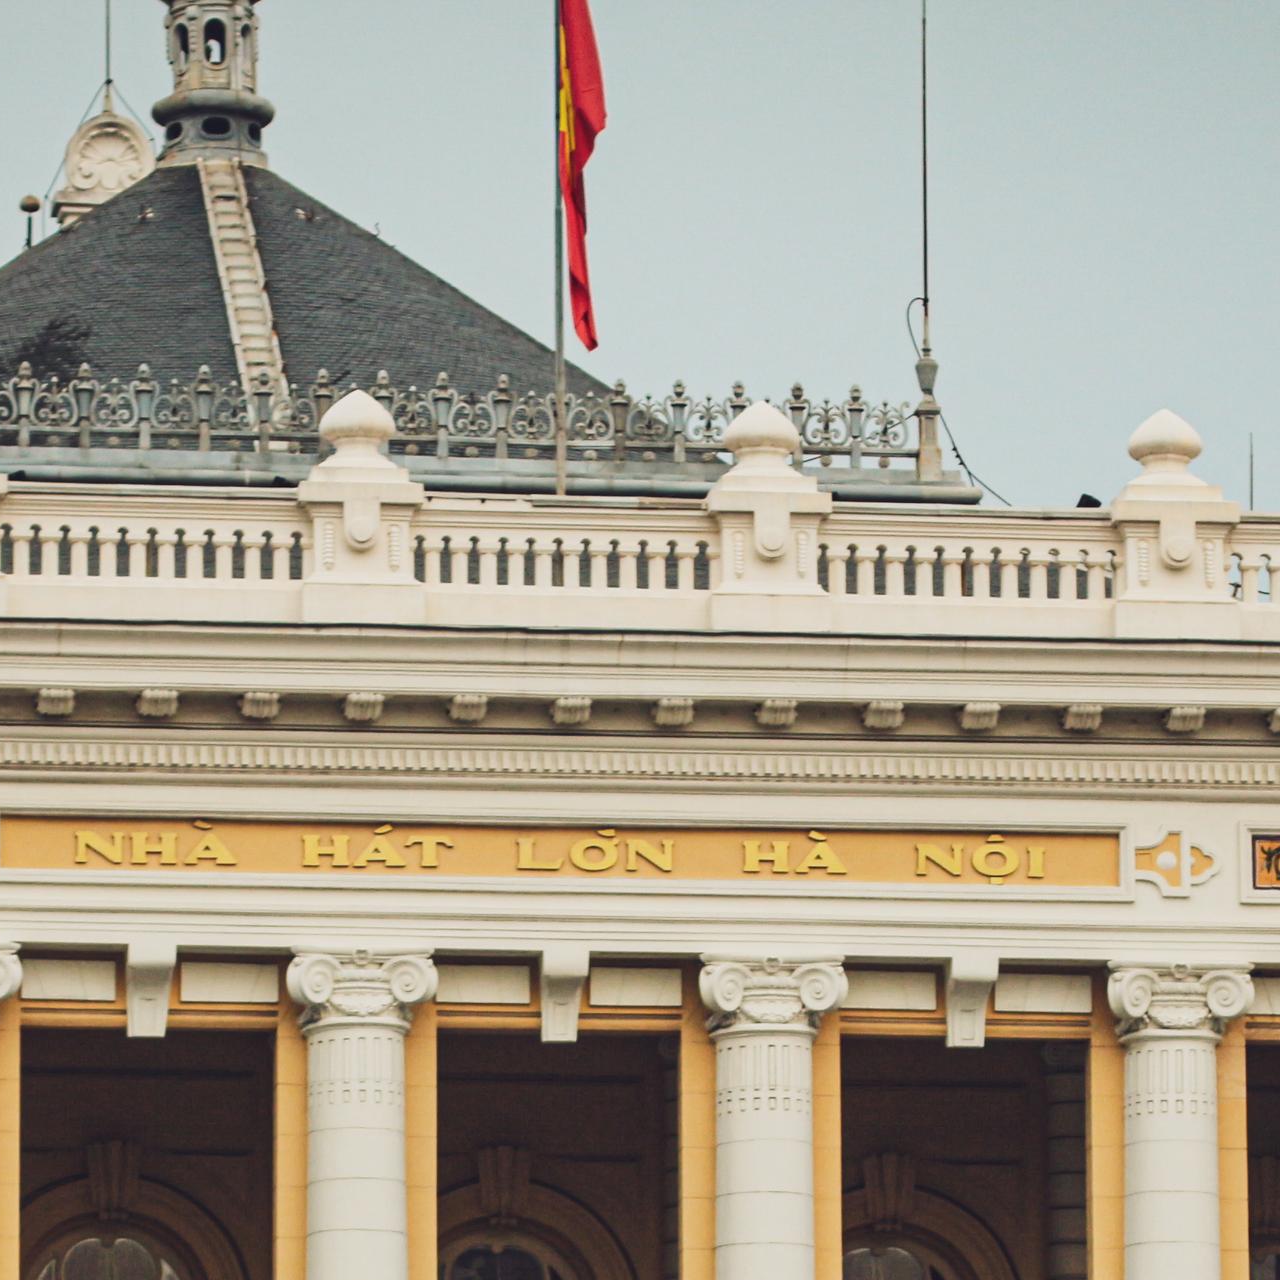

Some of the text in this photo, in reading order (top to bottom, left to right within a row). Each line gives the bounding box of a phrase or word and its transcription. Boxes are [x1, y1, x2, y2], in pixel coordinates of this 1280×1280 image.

[74, 820, 237, 866] NHÀ
[302, 824, 454, 868] HÁT
[741, 829, 848, 875] HÀ
[915, 834, 1046, 885] NỘI
